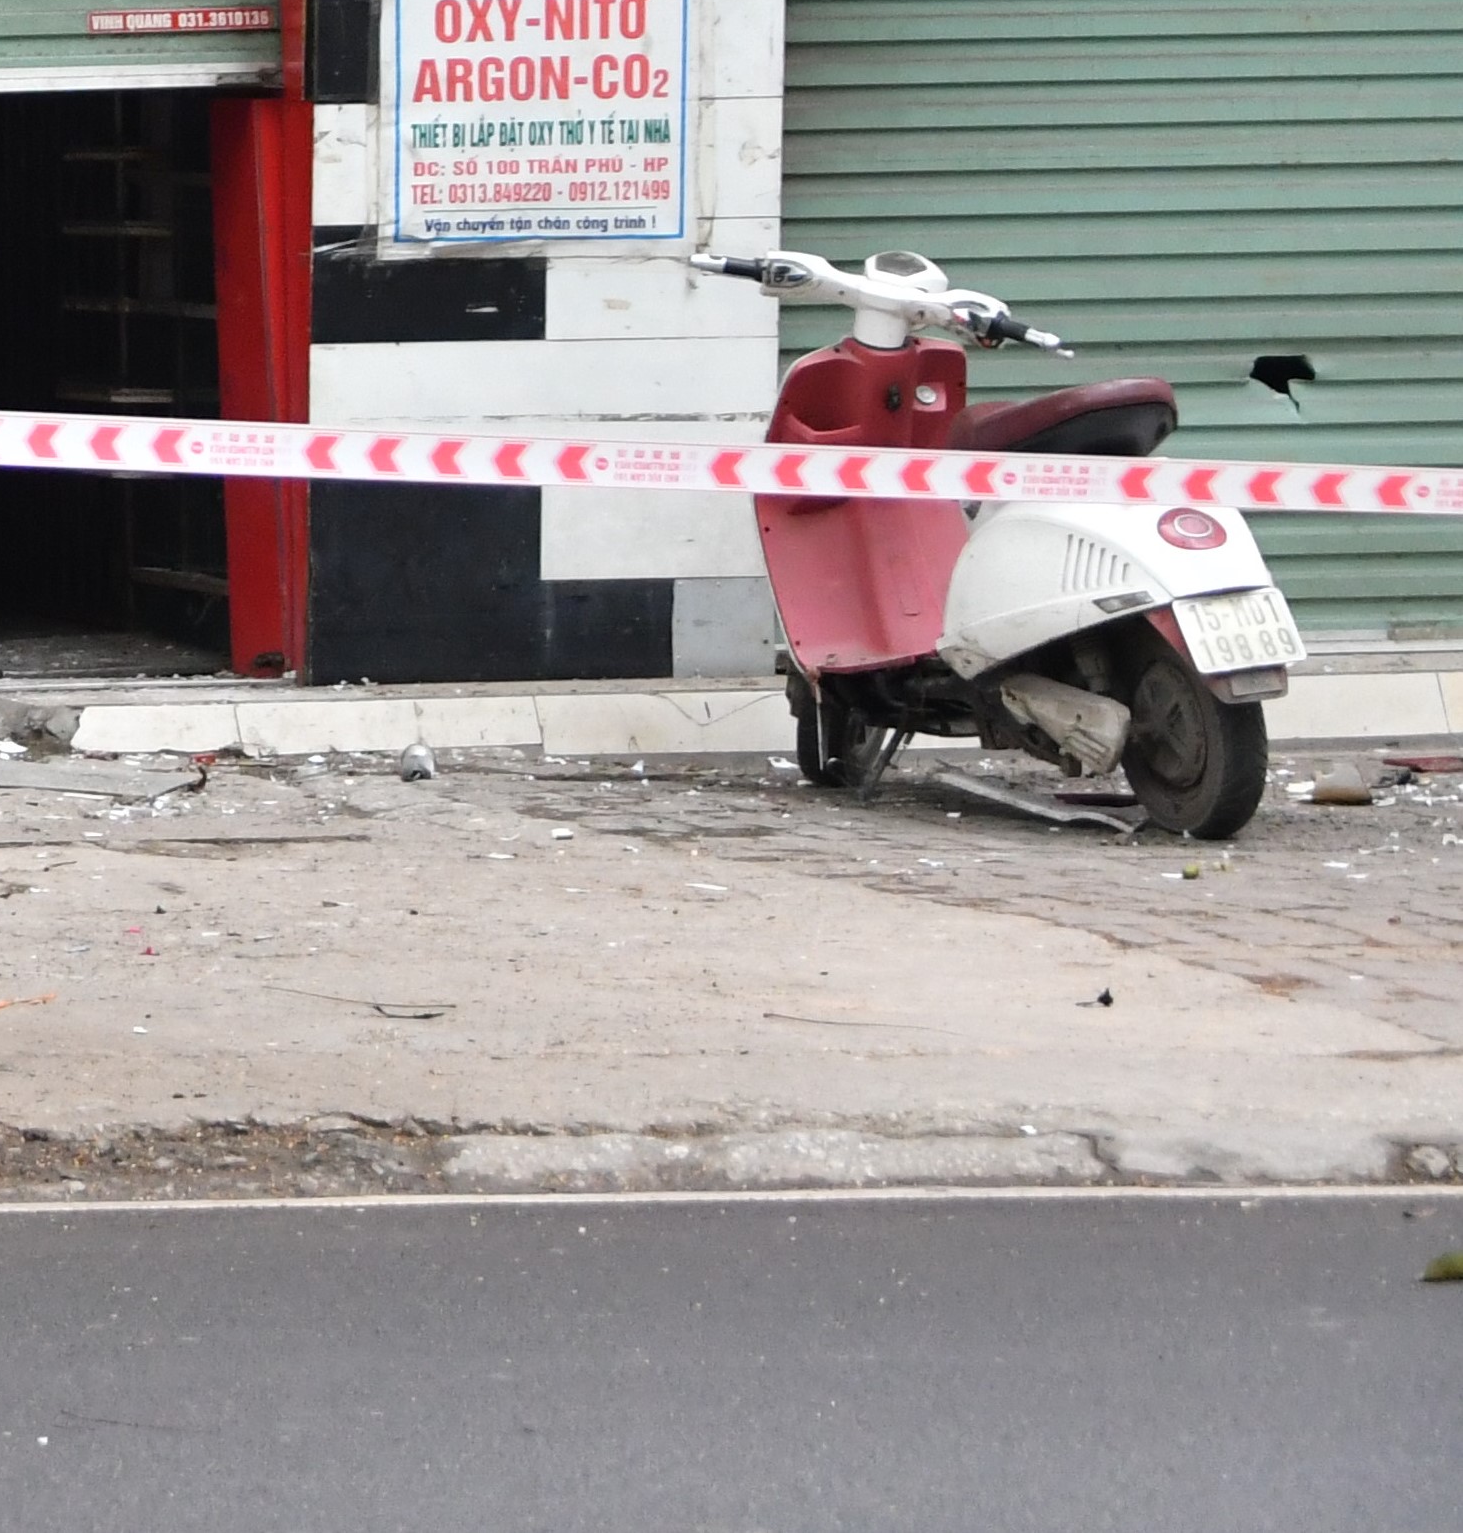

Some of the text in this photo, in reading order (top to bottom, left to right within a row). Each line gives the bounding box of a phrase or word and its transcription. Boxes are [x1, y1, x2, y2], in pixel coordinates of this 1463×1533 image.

[92, 15, 124, 30] VINH
[126, 13, 172, 31] QUANG
[528, 119, 554, 146] OXY
[487, 159, 520, 175] 100
[644, 157, 669, 172] HP
[412, 184, 443, 205] TEL:
[448, 182, 552, 204] 0313.849220
[568, 180, 671, 203] 0912.121499
